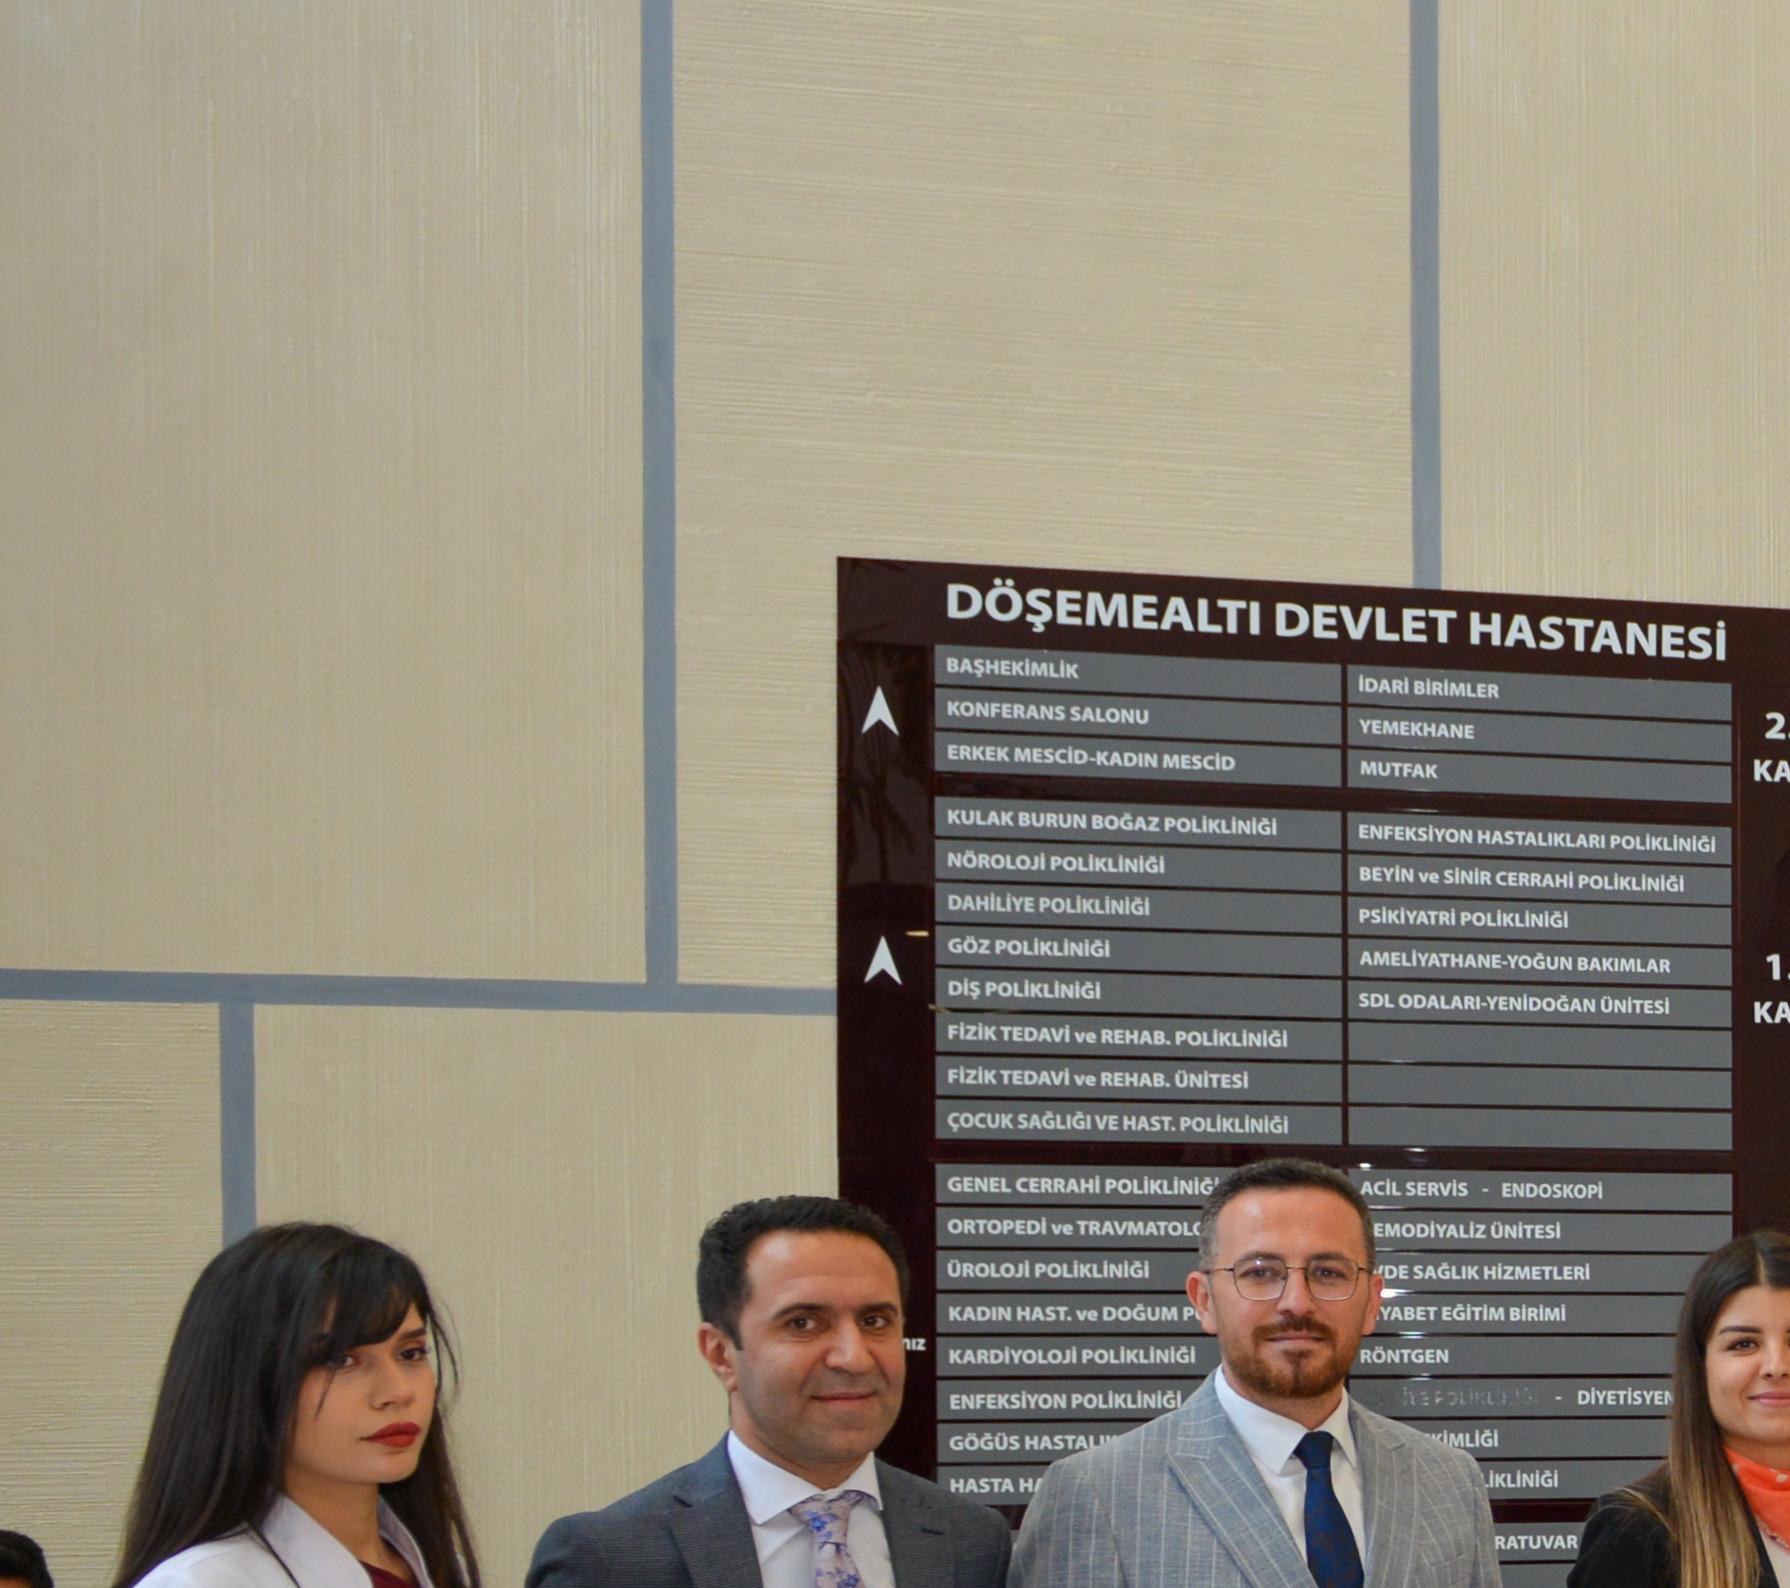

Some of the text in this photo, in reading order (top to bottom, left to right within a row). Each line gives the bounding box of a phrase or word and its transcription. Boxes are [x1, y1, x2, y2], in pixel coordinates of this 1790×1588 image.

[946, 577, 1727, 661] DÖŞEMEALTI DEVLET HASTANESİ
[946, 657, 1079, 680] BAŞHEKİMLİK
[1358, 674, 1500, 699] İDARİ BİRİMLER
[947, 700, 1150, 726] KONFERANS SALONU
[1359, 718, 1476, 740] YEMEKHANE
[947, 744, 1236, 772] ERKEK MESCİD-KADIN MESCİD
[1359, 760, 1439, 780] MUTFAK
[947, 808, 1278, 836] KULAK BURUN BOĞAZ POLİKLİNİĞİ
[1358, 824, 1717, 854] ENFEKSİYON HASTALIKLARI POLİKLİNİĞİ
[947, 850, 1166, 875] NÖROLOJİ POLİKLİNİĞİ
[1358, 865, 1686, 893] BEYİN ve SİNİR CERRAHİ POLİKLİNİĞİ
[947, 893, 1151, 916] DAHİLİYE POLİKLİNİĞİ
[1358, 905, 1570, 929] PSİKİYATRİ POLİKLİNİĞİ
[947, 936, 1111, 959] GÖZ POLİKLİNİĞİ
[1359, 948, 1671, 974] AMELİYATHANE-YOĞUN BAKIMLAR
[947, 978, 1102, 1000] DİŞ POLİKLİNİĞİ
[1358, 992, 1671, 1015] SDL ODALARI-YENİDOĞAN ÜNİTESİ
[947, 1022, 1289, 1048] FİZİK TEDAVİ ve REHAB. POLİKLİNİĞİ
[947, 1066, 1250, 1090] FİZİK TEDAVİ ve REHAB. ÜNİTESİ
[947, 1110, 1290, 1135] ÇOCUK SAĞLIĞI VE HAST. POLİKLİNİĞİ
[947, 1174, 1220, 1196] GENEL CERRAHİ POLİKLİNİĞ
[1360, 1177, 1402, 1197] ACİL
[1405, 1178, 1469, 1198] SERVİS
[1501, 1181, 1604, 1200] ENDOSKOPİ
[947, 1217, 1047, 1235] ORTOPEDİ
[1051, 1223, 1074, 1236] ve
[1373, 1220, 1562, 1240] EMODİYALİZ ÜNİTESİ
[946, 1259, 1150, 1279] ÜROLOJİ POLİKLİNİĞİ
[1413, 1262, 1480, 1281] SAĞLIK
[1483, 1263, 1591, 1281] HİZMETLERİ
[948, 1306, 1009, 1322] KADIN
[1016, 1306, 1073, 1322] HAST.
[1076, 1310, 1099, 1322] ve
[1101, 1304, 1179, 1322] DOĞUM
[1376, 1303, 1567, 1322] YABET EĞİTİM BİRİMİ
[948, 1345, 1196, 1365] KARDİYOLOJİ POLİKLİNİĞİ
[1359, 1346, 1450, 1364] RÖNTGEN
[949, 1390, 1182, 1410] ENFEKSİYON POLİKLİNİĞİ
[949, 1431, 1021, 1451] GÖĞÜS
[950, 1478, 1015, 1494] HASTA
[1494, 1534, 1578, 1550] RATUVAR
